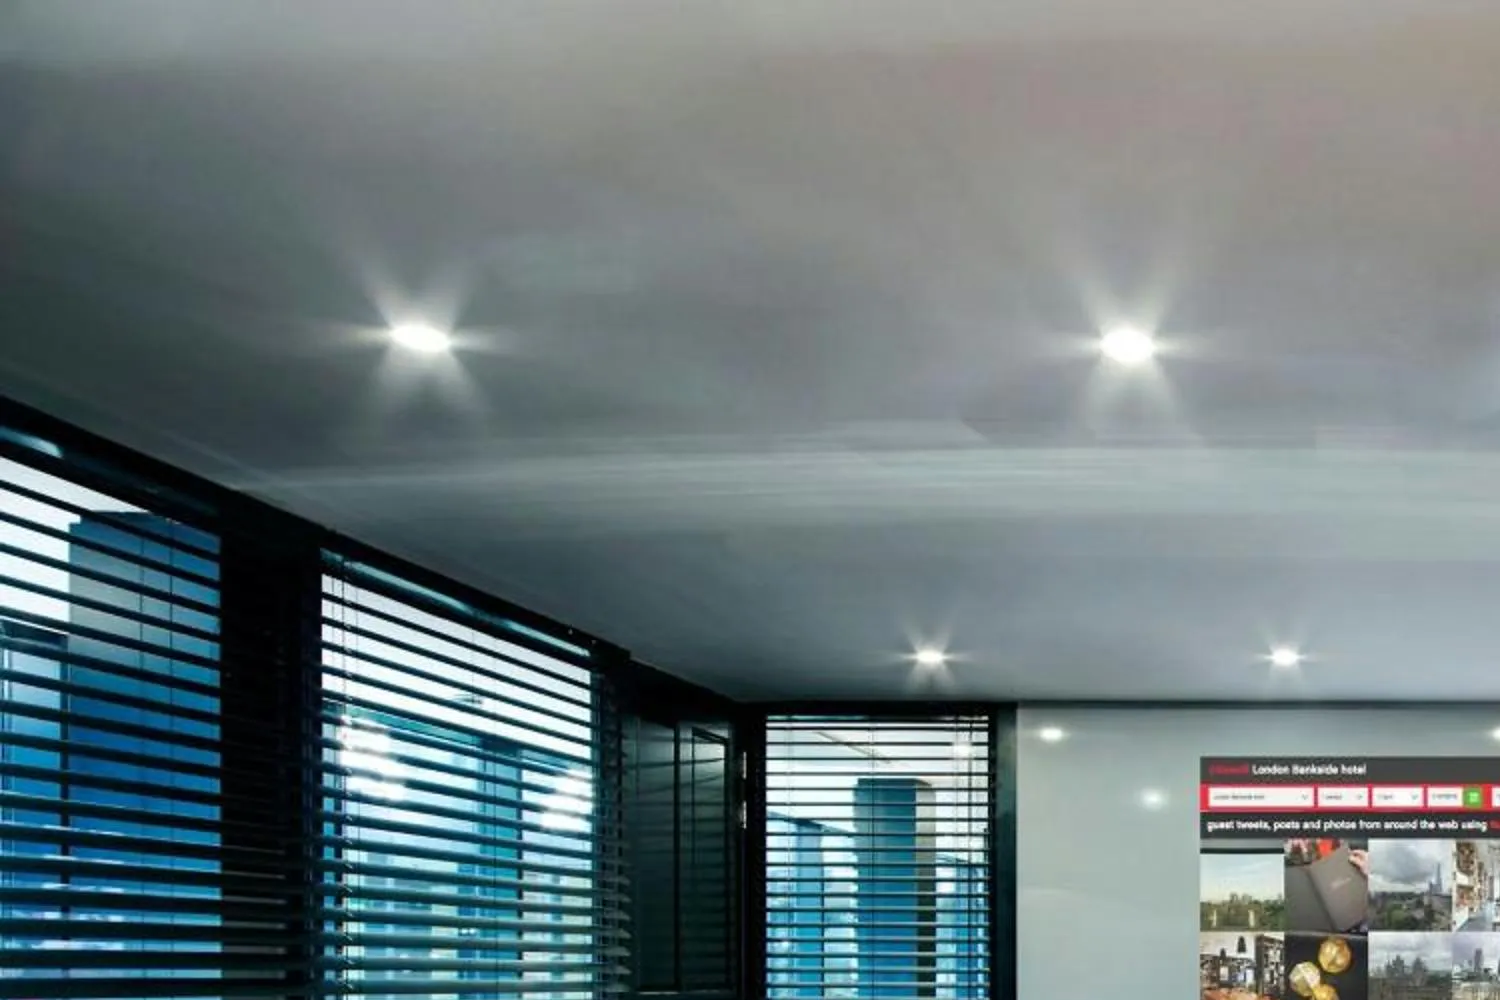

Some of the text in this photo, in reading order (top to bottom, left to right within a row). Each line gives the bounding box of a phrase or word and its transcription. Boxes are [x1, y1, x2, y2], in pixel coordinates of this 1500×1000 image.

[1252, 763, 1290, 776] London
[1292, 763, 1339, 776] Bankside
[1341, 763, 1367, 776] hotel
[1207, 820, 1235, 832] guest
[1273, 820, 1300, 832] posts
[1302, 819, 1321, 830] and
[1323, 819, 1357, 832] photos
[1359, 819, 1381, 830] from
[1383, 819, 1418, 830] around
[1419, 819, 1436, 830] the
[1437, 819, 1459, 830] web
[1461, 819, 1488, 833] using
